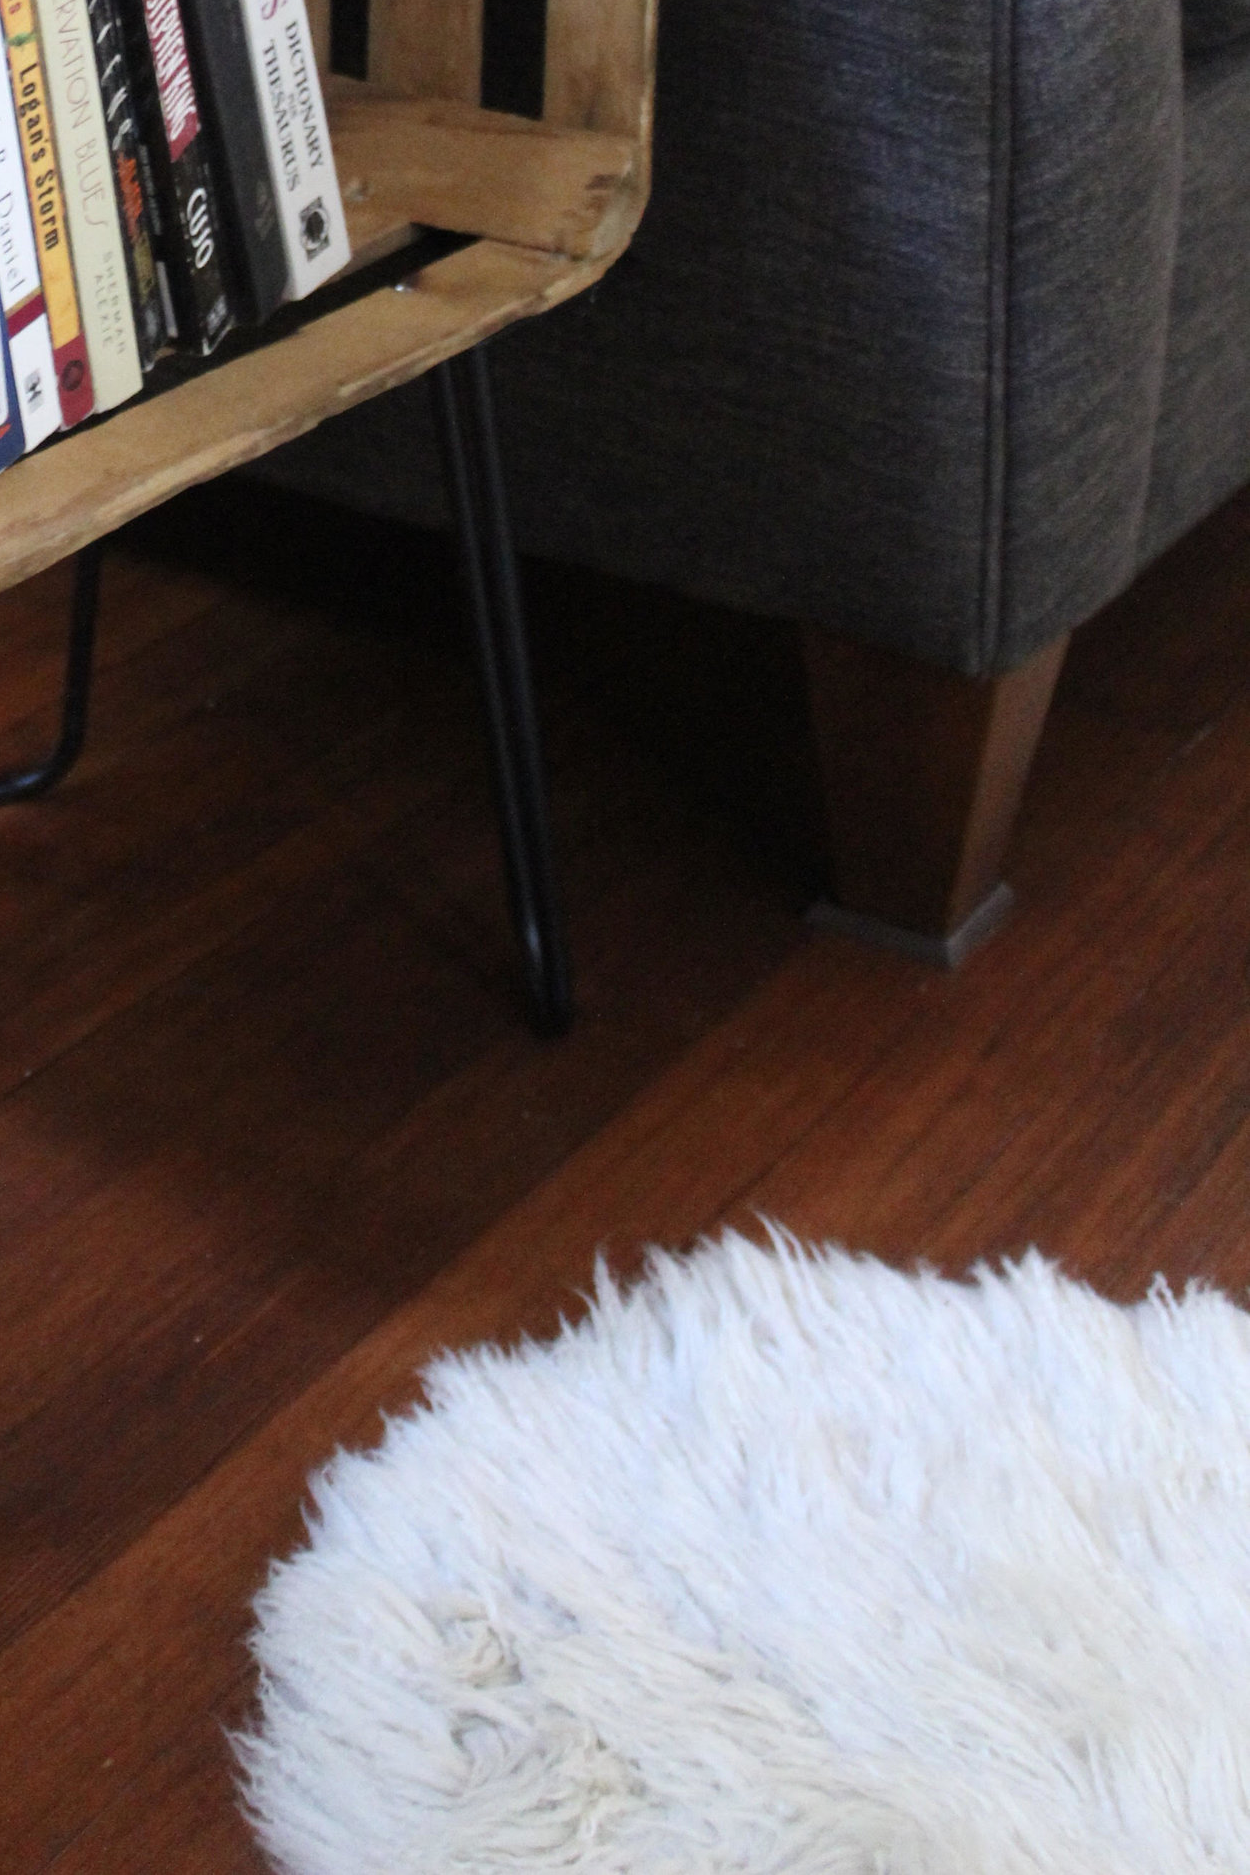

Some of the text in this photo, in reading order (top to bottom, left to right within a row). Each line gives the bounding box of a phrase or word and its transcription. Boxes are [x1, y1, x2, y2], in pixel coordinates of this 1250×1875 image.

[161, 59, 198, 142] KING
[262, 39, 301, 193] THESAURUS
[285, 20, 325, 168] DICTIONARY
[19, 62, 59, 251] Logan's Storm
[73, 138, 109, 227] BLUES
[186, 186, 214, 269] CUJO
